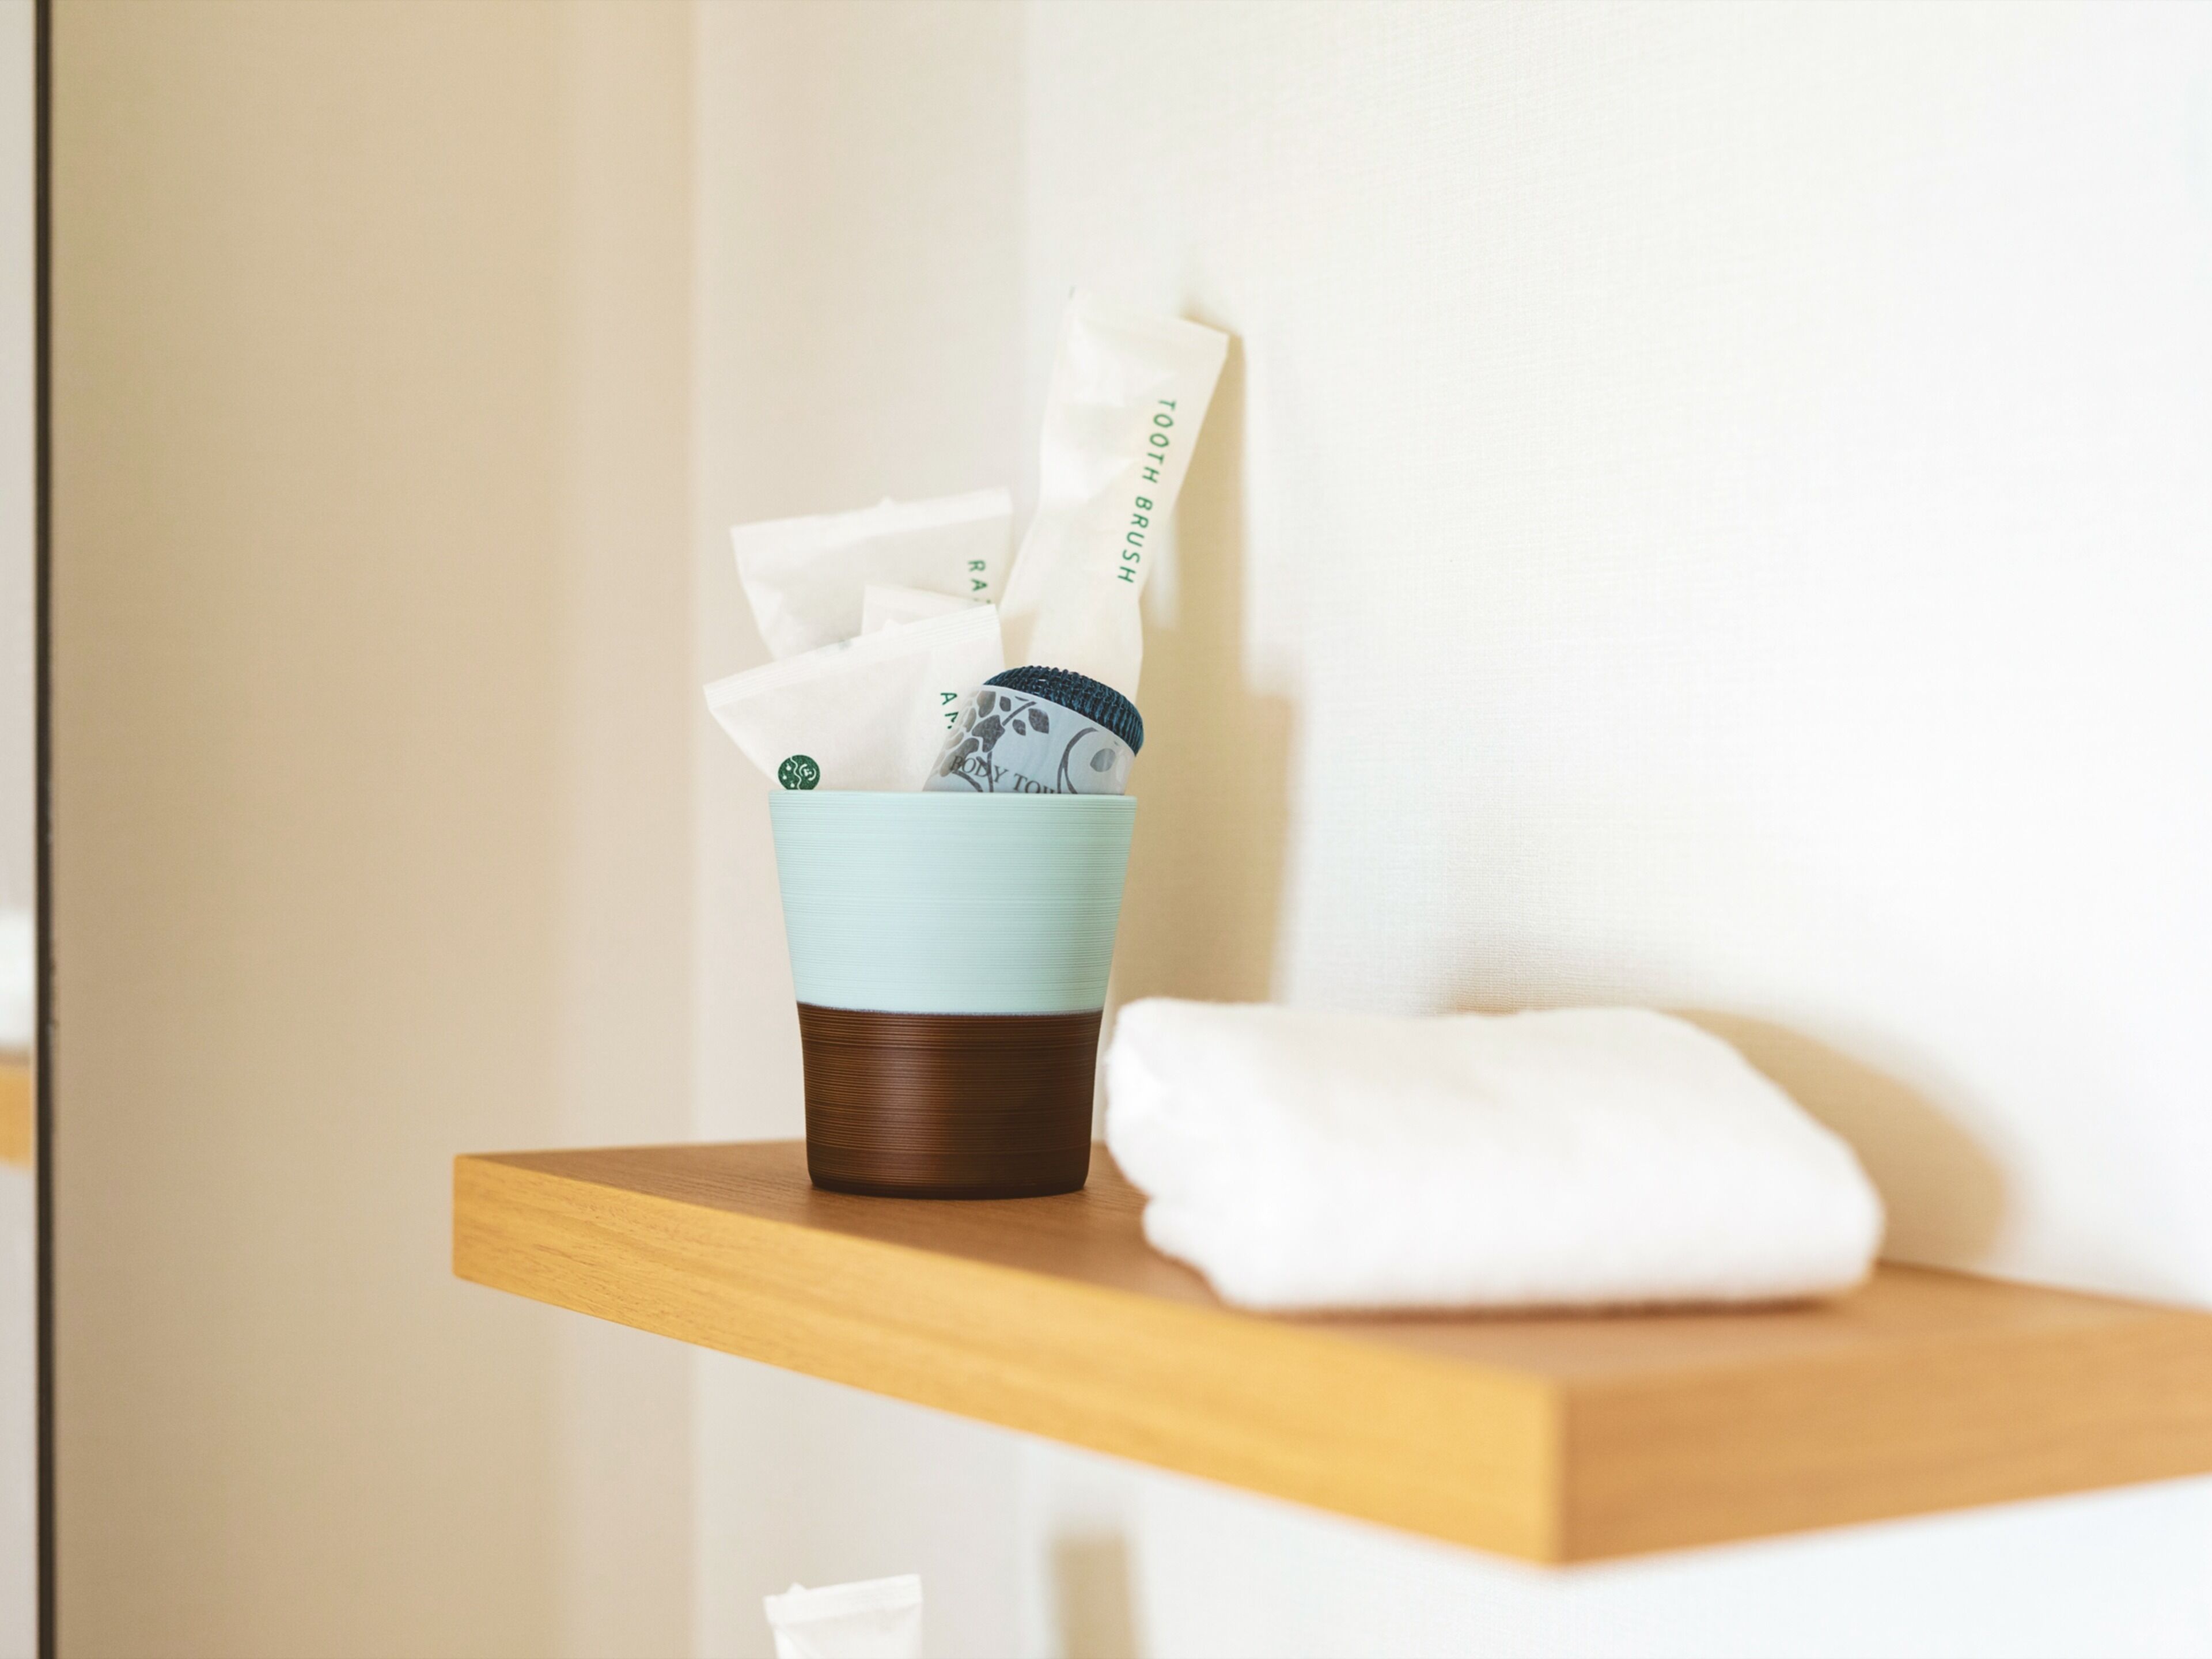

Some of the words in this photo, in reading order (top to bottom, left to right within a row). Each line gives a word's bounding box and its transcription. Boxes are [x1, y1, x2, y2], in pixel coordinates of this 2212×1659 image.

[1142, 399, 1177, 484] TOOTH
[1117, 495, 1153, 584] BRUSH
[967, 560, 991, 604] RA
[949, 755, 1009, 783] BODY
[1013, 772, 1056, 794] TO
